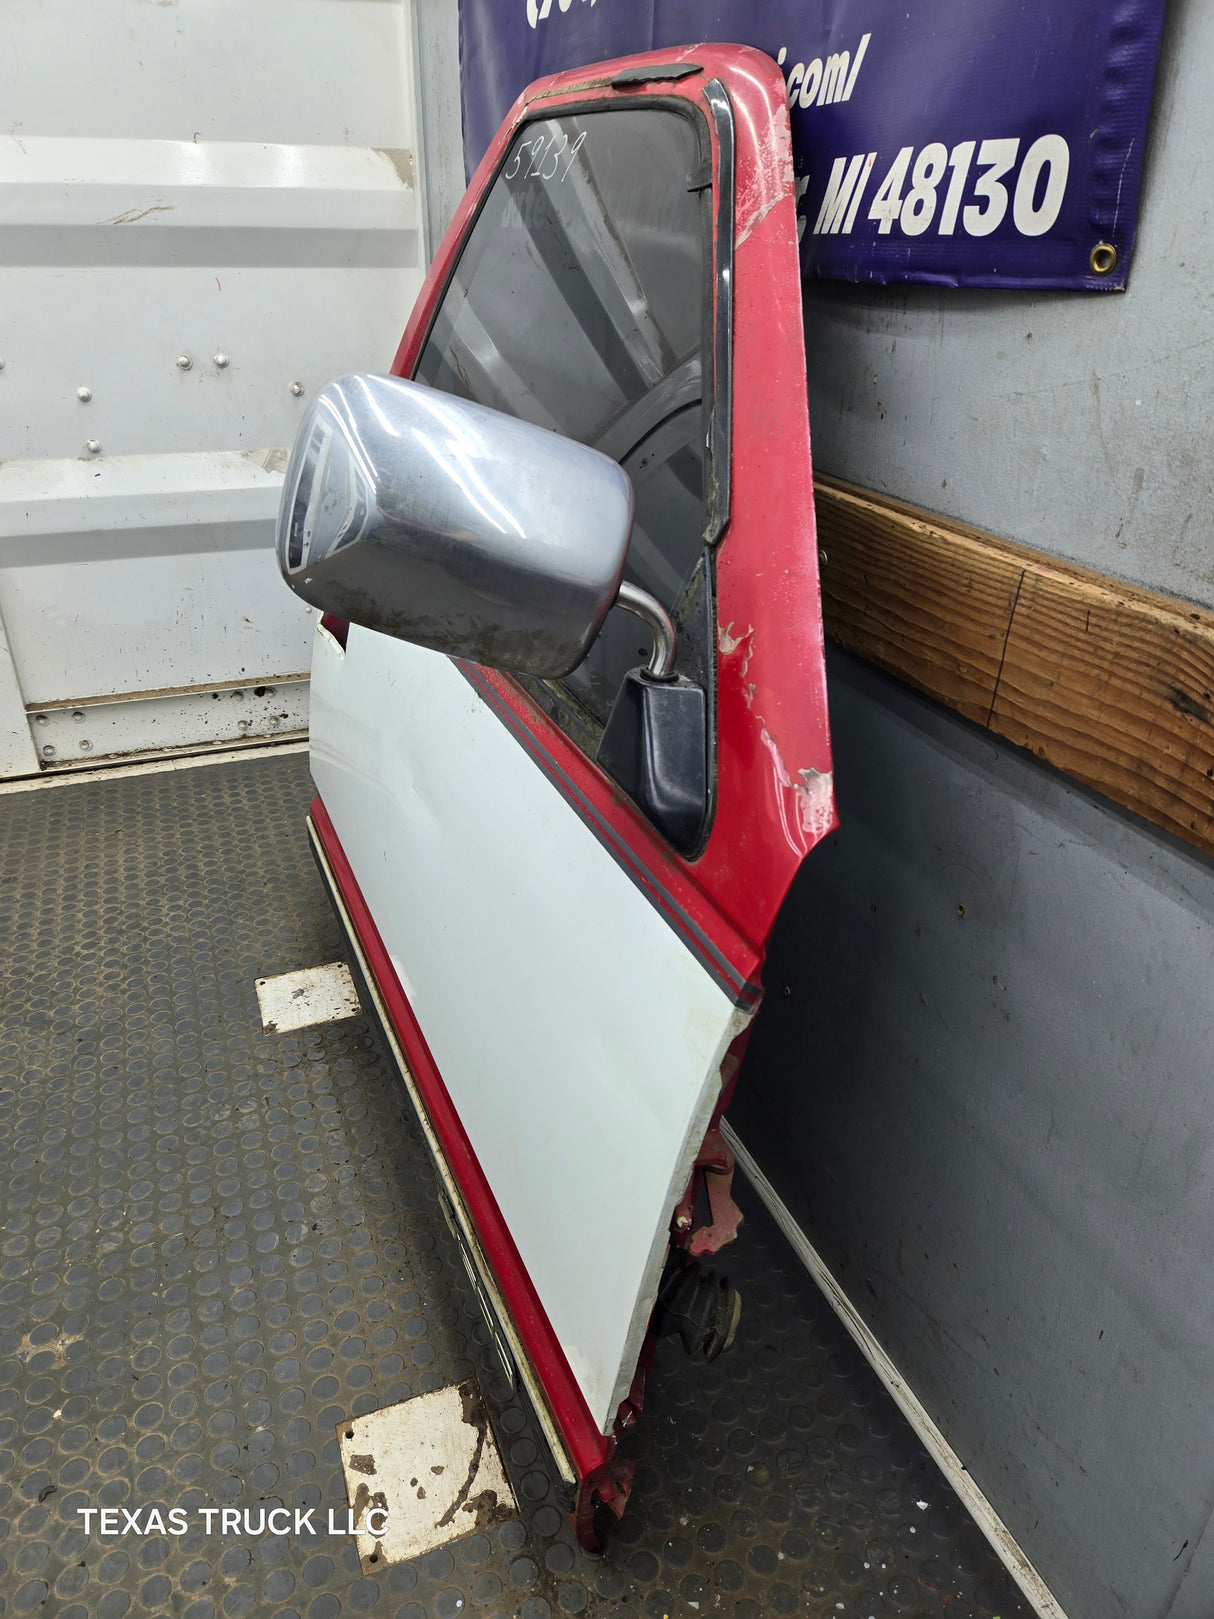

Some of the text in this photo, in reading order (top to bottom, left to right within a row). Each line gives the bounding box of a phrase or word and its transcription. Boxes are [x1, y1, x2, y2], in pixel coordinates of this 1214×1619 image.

[777, 32, 872, 110] com/
[505, 131, 587, 182] 59139
[813, 152, 877, 235] MI
[868, 134, 1070, 237] 48130
